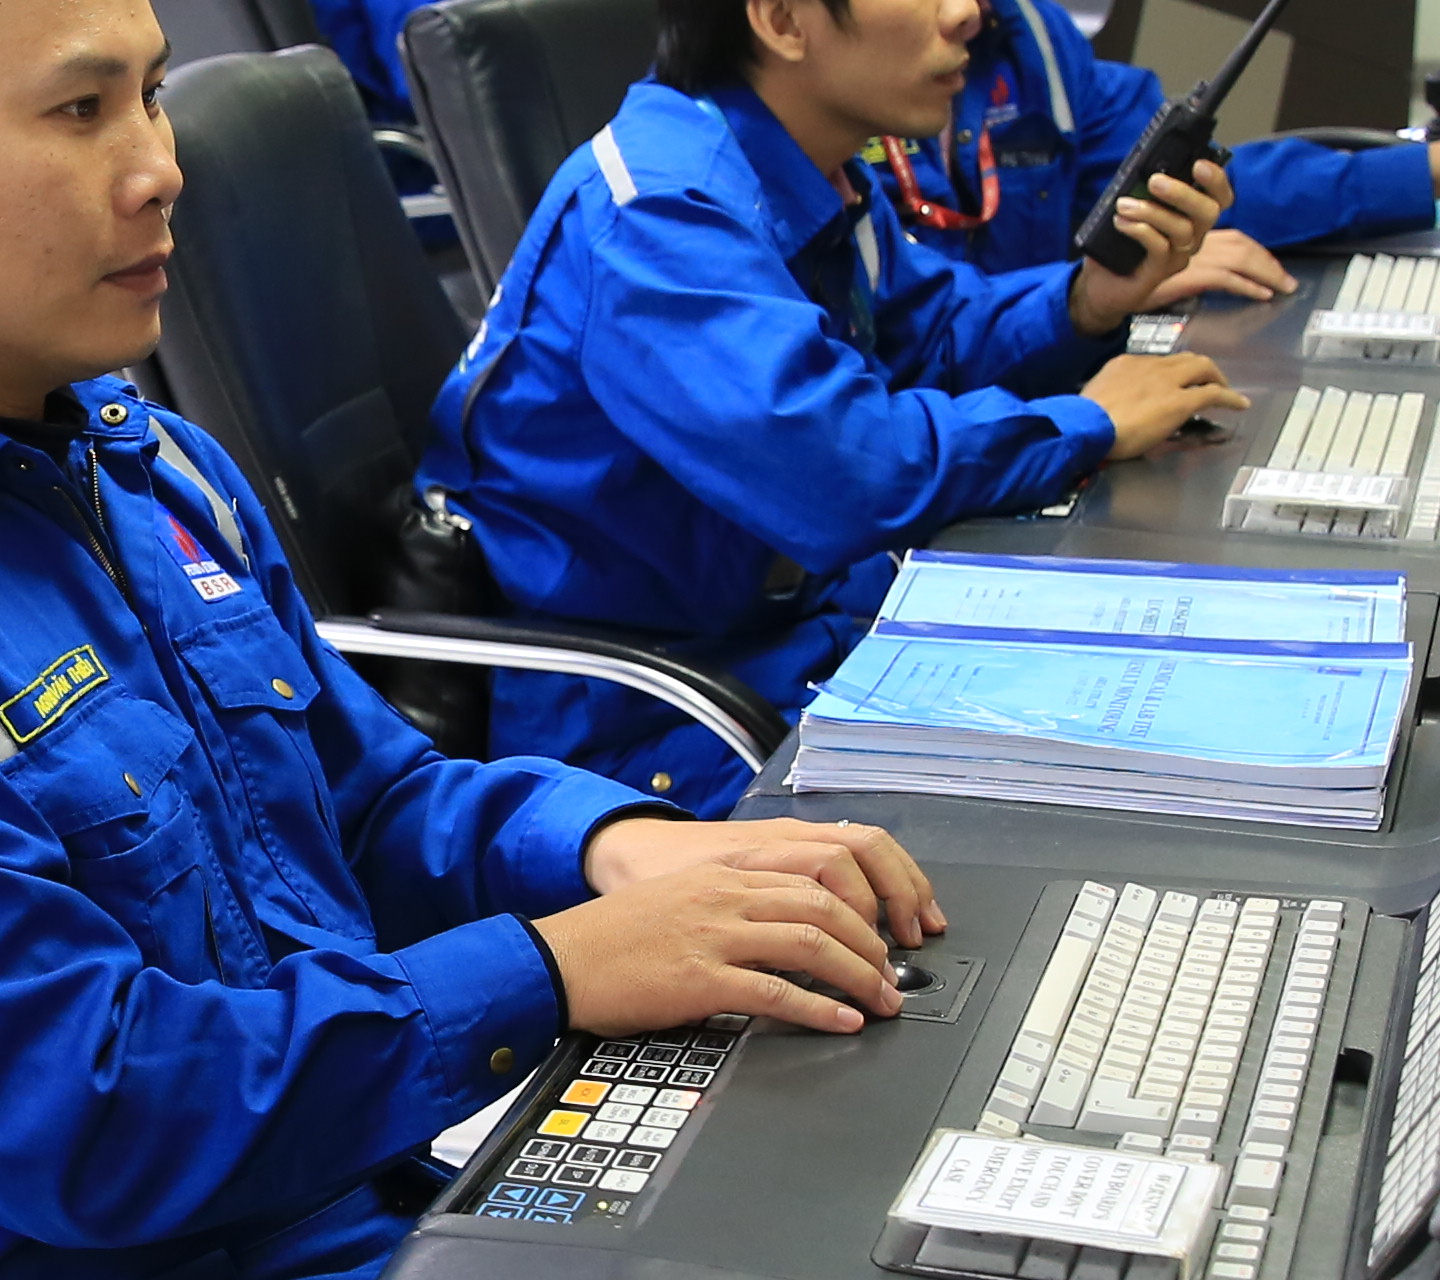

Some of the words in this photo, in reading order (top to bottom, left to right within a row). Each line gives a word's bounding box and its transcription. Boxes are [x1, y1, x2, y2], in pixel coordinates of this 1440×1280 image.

[200, 576, 236, 596] BSR
[1128, 720, 1153, 738] TEST
[943, 1159, 971, 1183] CASE
[1042, 1155, 1073, 1192] TOUCH
[1072, 1155, 1104, 1190] COVER
[994, 1177, 1029, 1211] EXCEPT
